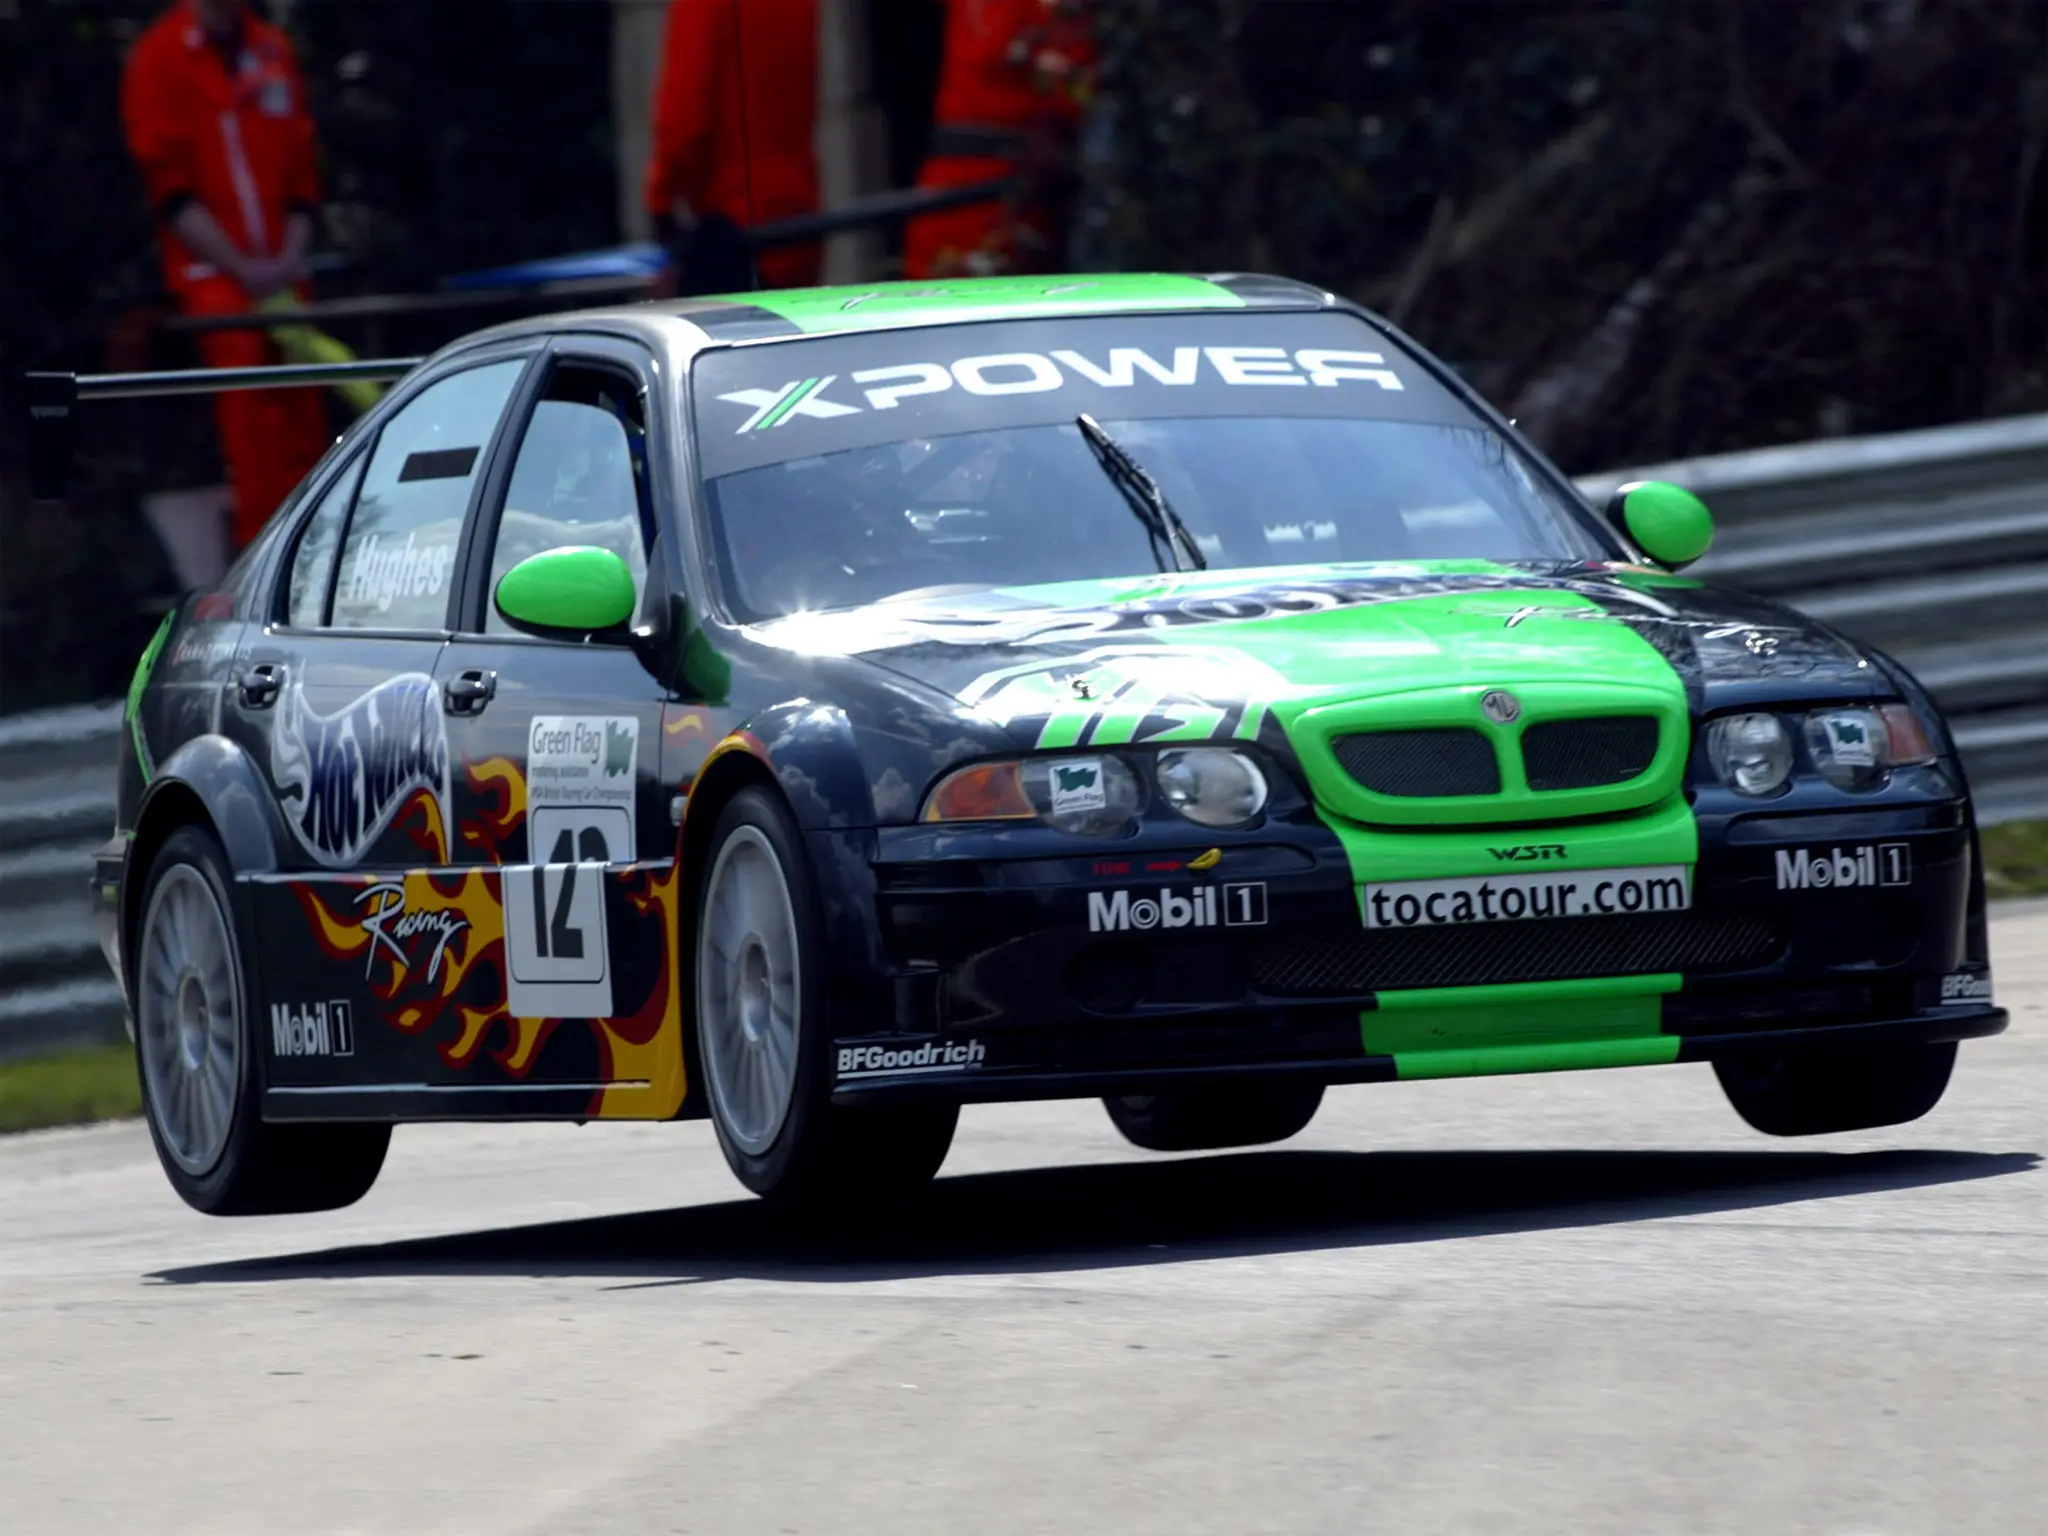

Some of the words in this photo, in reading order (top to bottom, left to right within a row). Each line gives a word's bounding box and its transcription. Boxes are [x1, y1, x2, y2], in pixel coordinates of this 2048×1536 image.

[349, 532, 448, 612] Hughes
[532, 722, 571, 754] Green
[573, 722, 602, 764] Flag
[1486, 844, 1569, 860] WSR
[1775, 846, 1875, 890] Mobil
[1088, 886, 1217, 932] Mobil
[1371, 877, 1684, 927] tocatour.com
[353, 883, 469, 984] Racing
[271, 1003, 330, 1056] Mobil
[837, 1039, 986, 1072] BFGoodrich
